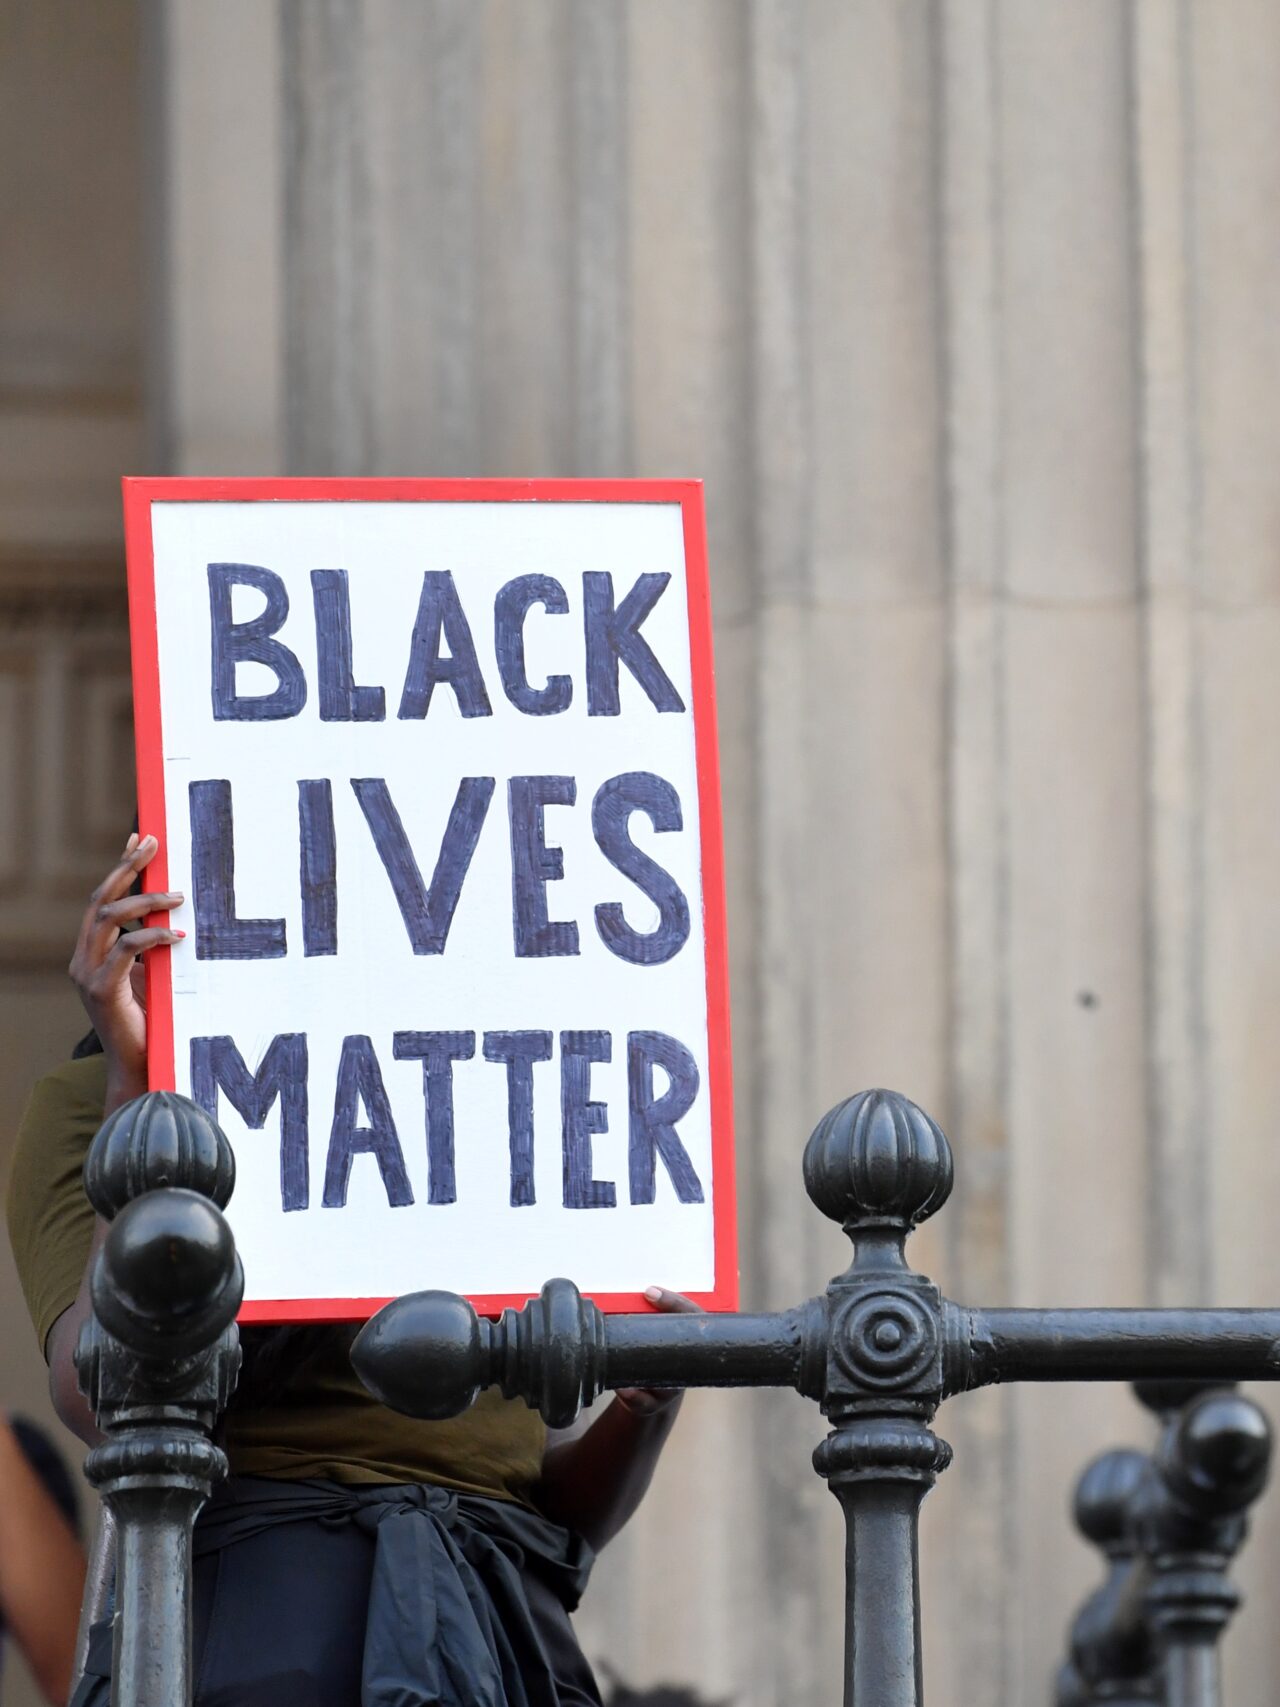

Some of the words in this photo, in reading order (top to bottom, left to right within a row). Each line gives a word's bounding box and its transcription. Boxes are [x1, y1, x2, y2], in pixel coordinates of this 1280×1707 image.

[206, 562, 686, 722] BLACK
[189, 771, 691, 967] LIVES
[190, 1030, 706, 1212] MATTER
